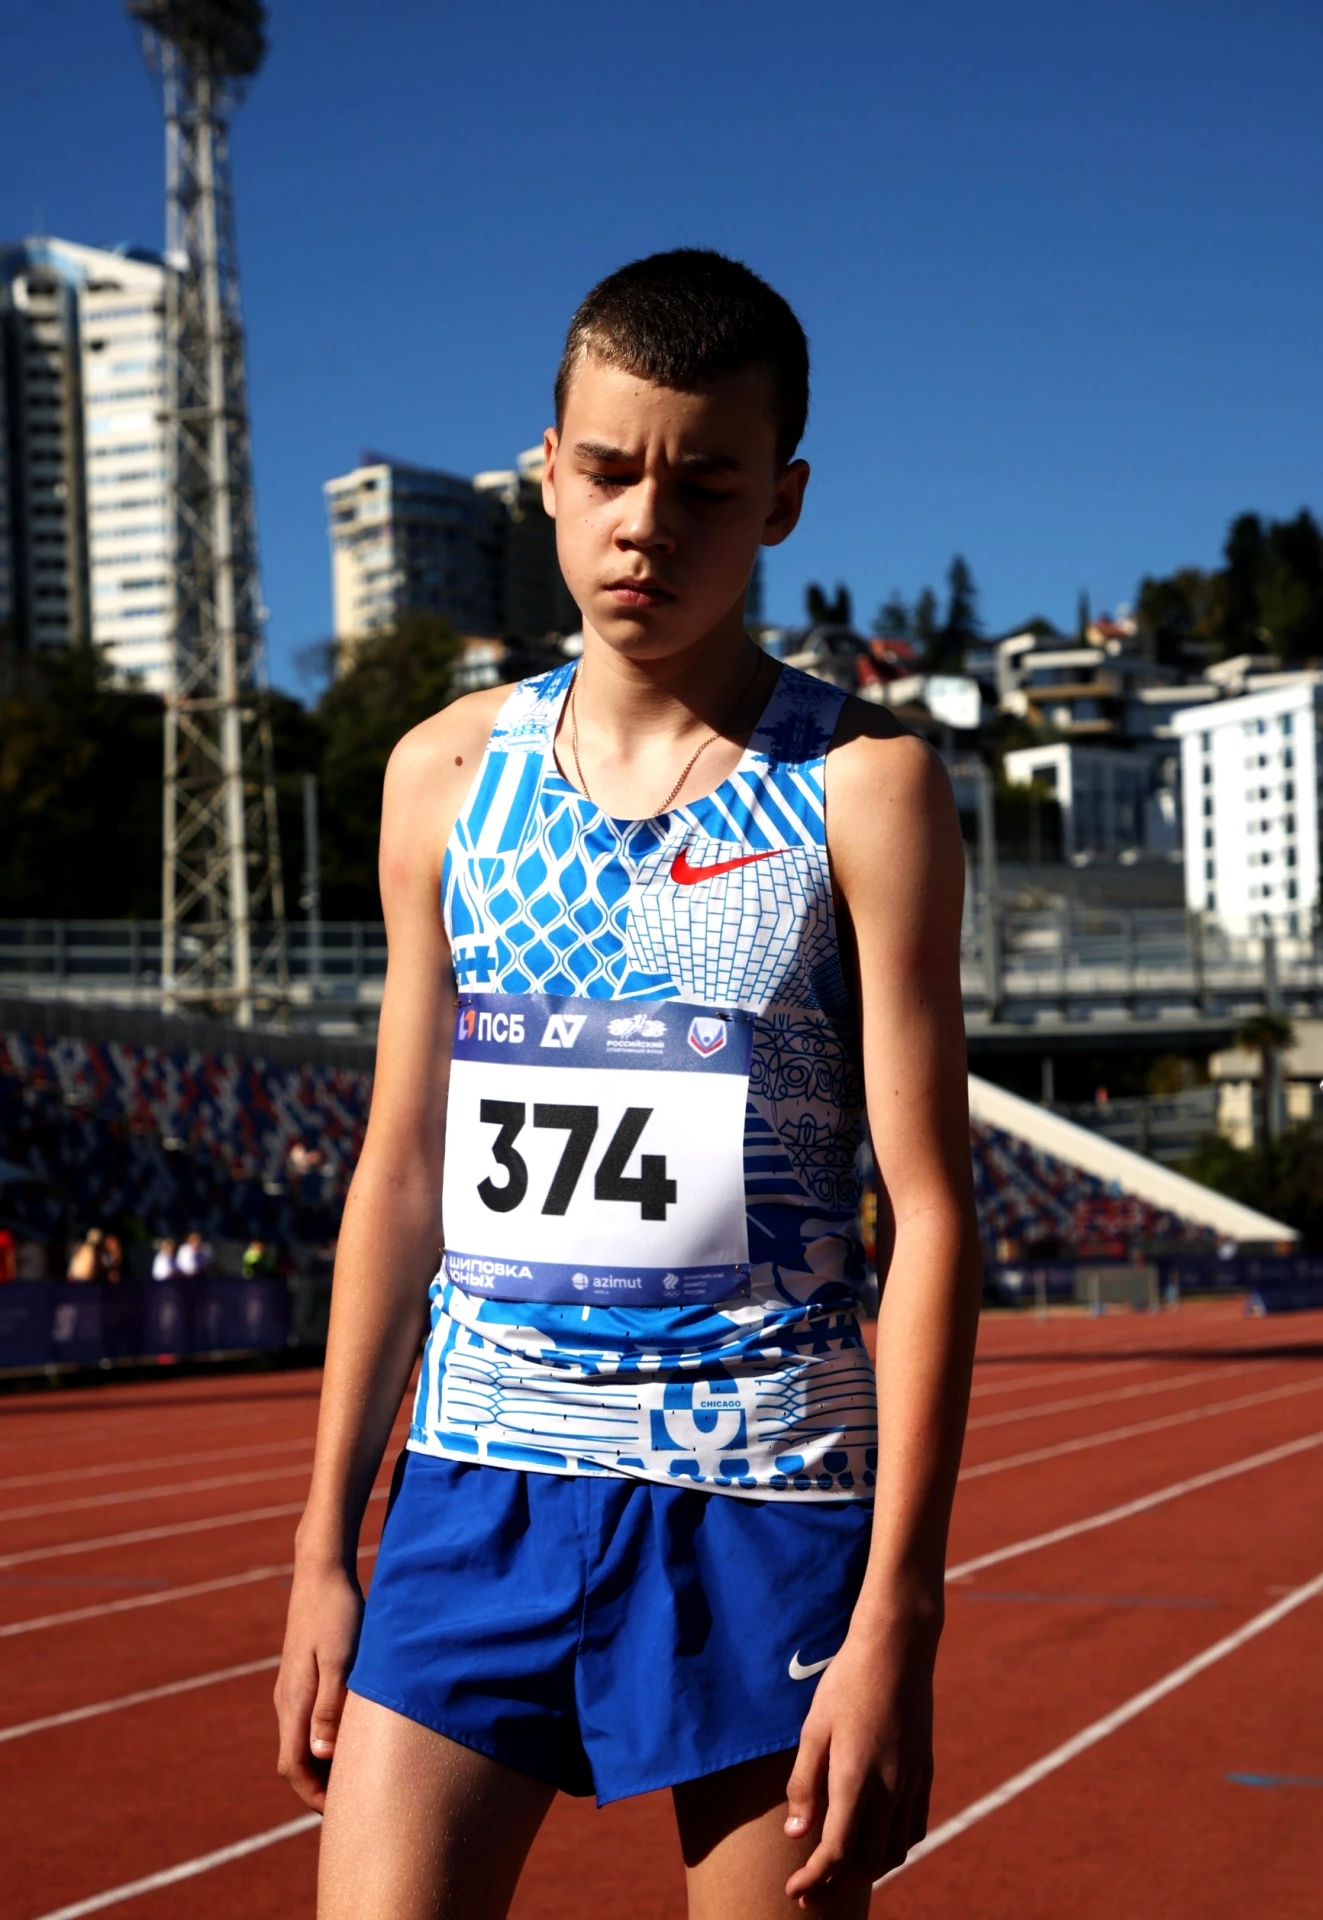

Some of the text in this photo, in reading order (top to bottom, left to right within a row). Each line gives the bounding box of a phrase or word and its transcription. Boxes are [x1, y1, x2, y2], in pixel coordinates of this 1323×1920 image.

[478, 1011, 525, 1044] ПСБ
[477, 1099, 677, 1221] 374
[449, 1255, 533, 1280] ШИПОВКА
[593, 1274, 643, 1289] azimut
[700, 1400, 741, 1408] CHICAGO
